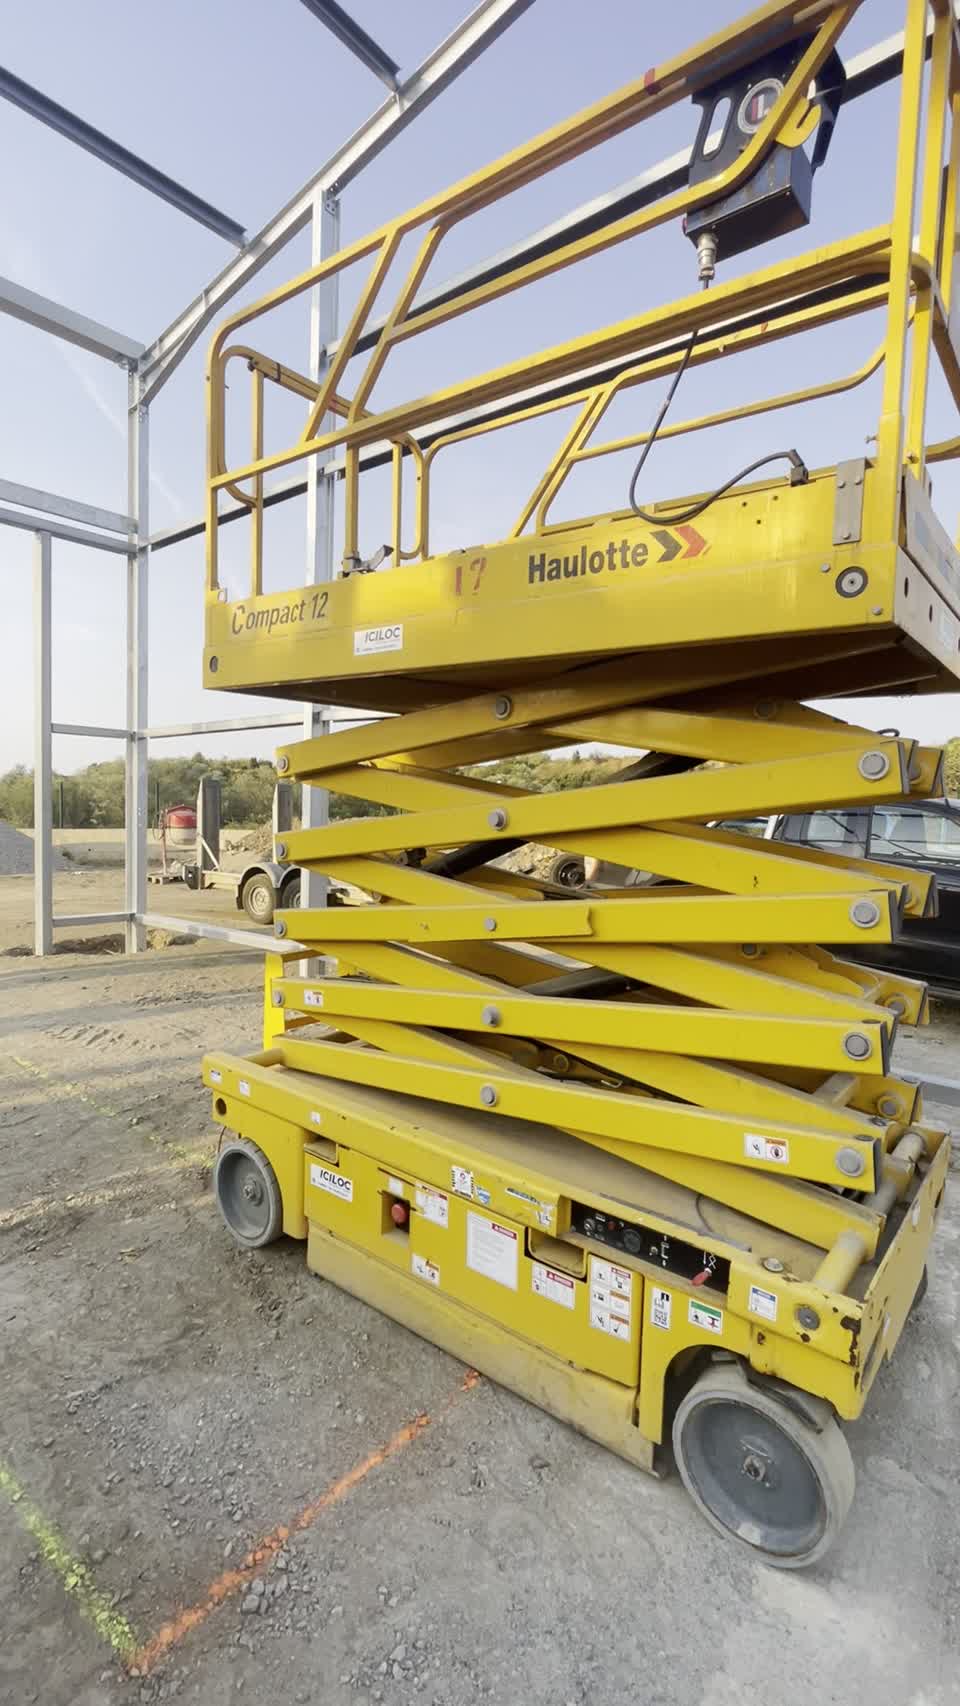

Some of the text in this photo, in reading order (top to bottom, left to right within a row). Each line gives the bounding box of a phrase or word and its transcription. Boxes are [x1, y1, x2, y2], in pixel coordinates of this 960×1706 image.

[528, 538, 649, 584] Haulotte
[232, 592, 329, 634] Compact 12
[364, 626, 401, 644] ICILOC
[320, 1169, 352, 1191] ICILOC
